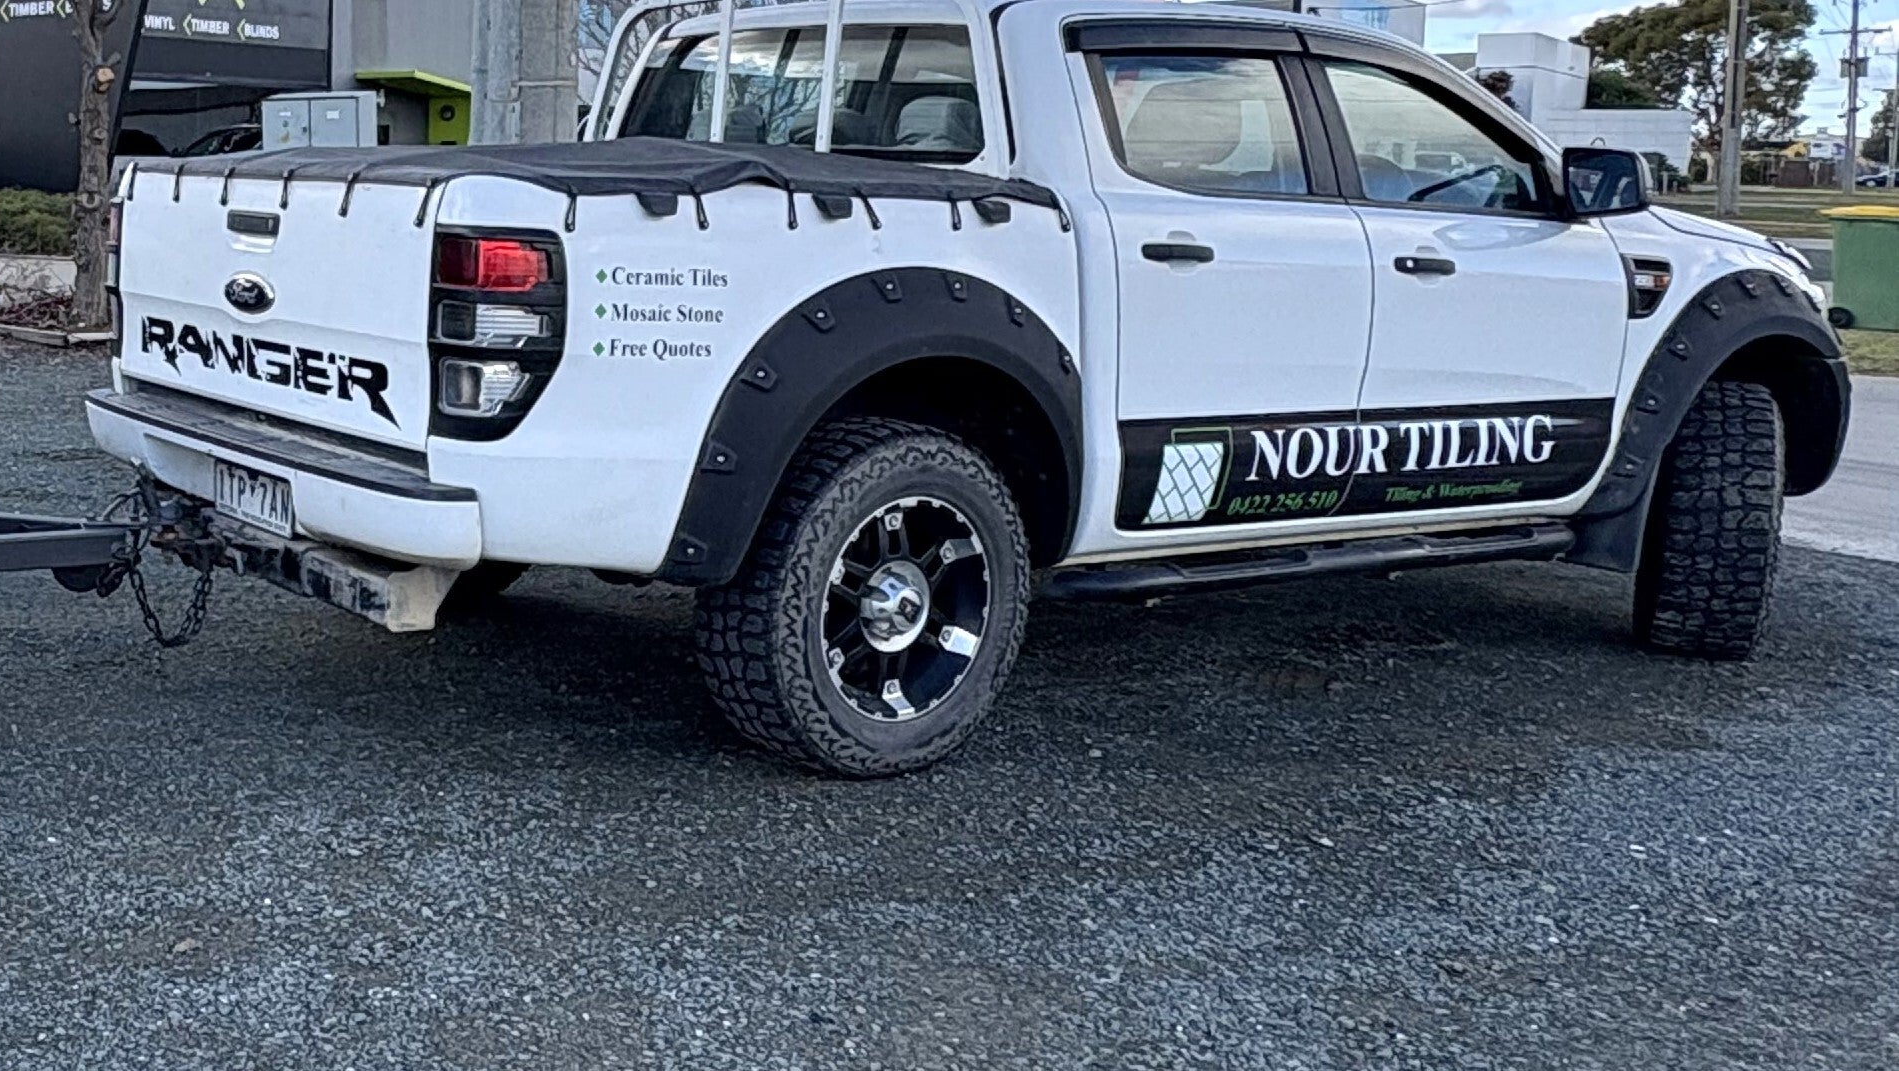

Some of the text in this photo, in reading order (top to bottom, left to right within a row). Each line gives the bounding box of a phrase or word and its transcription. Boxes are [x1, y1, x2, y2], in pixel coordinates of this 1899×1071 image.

[8, 0, 56, 18] TIMBER
[144, 14, 280, 40] VINYL TIMBER BLINDS
[612, 266, 728, 287] Ceramic Tiles
[610, 303, 725, 323] Mosaic Stone
[609, 338, 712, 361] Free Quotes
[141, 315, 402, 431] RANGER
[1245, 414, 1556, 481] NOUR TILING
